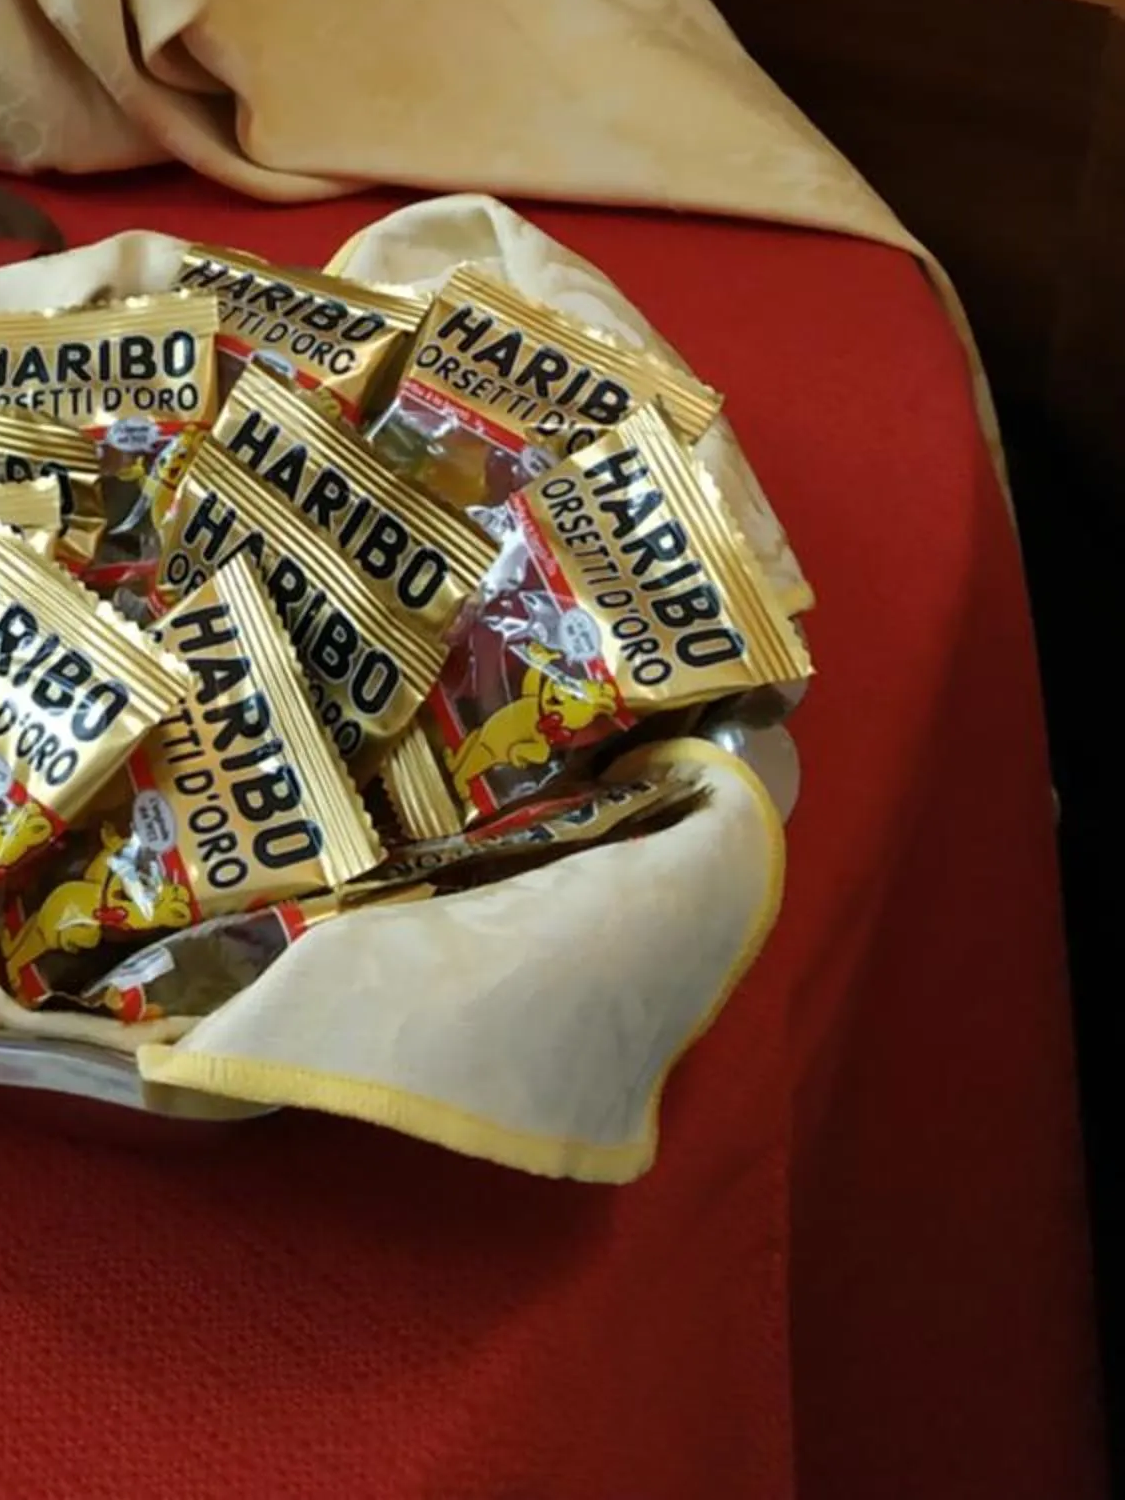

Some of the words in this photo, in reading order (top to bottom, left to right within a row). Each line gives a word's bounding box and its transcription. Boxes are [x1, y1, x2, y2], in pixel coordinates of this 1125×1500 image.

[179, 259, 386, 342] HARIBO
[437, 305, 632, 426] HARIB
[103, 383, 199, 412] D'ORO
[416, 344, 540, 421] ORSETTI
[227, 410, 449, 609] HARIBO
[540, 477, 621, 586] ORSETTI
[595, 589, 673, 687] D'ORO
[584, 446, 745, 668] HARIBO
[183, 491, 401, 715] HARIBO
[171, 603, 324, 870] HARIBO
[174, 769, 249, 890] D'ORO
